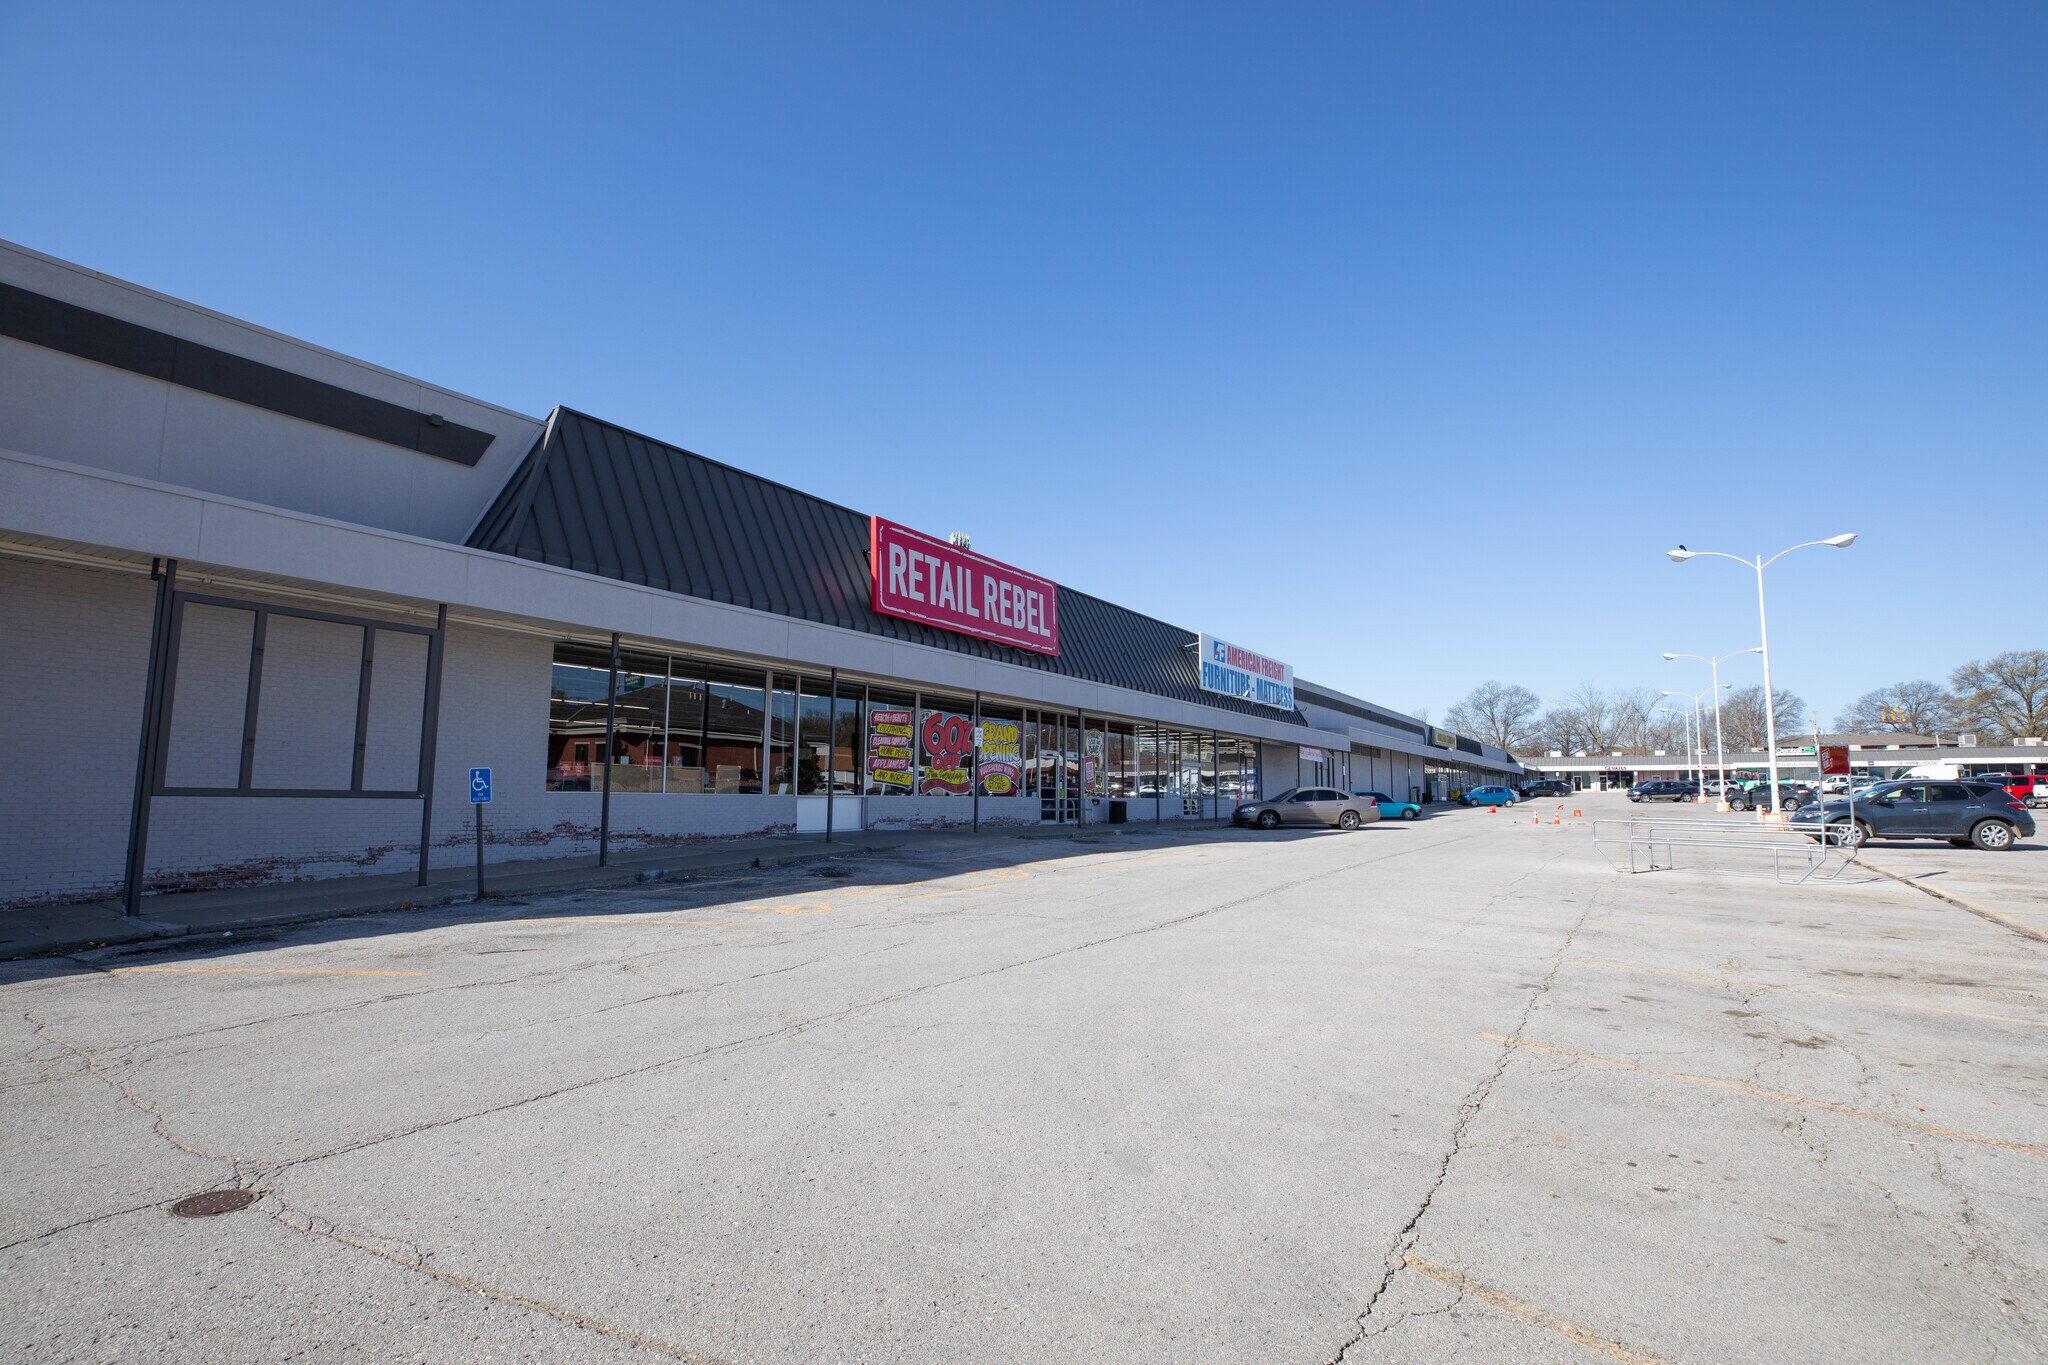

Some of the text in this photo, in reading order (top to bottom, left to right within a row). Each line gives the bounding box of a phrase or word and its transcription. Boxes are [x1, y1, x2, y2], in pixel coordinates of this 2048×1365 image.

[889, 543, 1051, 637] RETAIL REBEL
[1226, 645, 1261, 674] AMERICAN
[1262, 657, 1285, 682] FREIGHT
[1202, 661, 1251, 698] FURNITURE
[1256, 678, 1293, 709] MATTRESS
[923, 713, 975, 755] 60%
[982, 721, 1019, 743] GRAND
[933, 753, 961, 771] OFF
